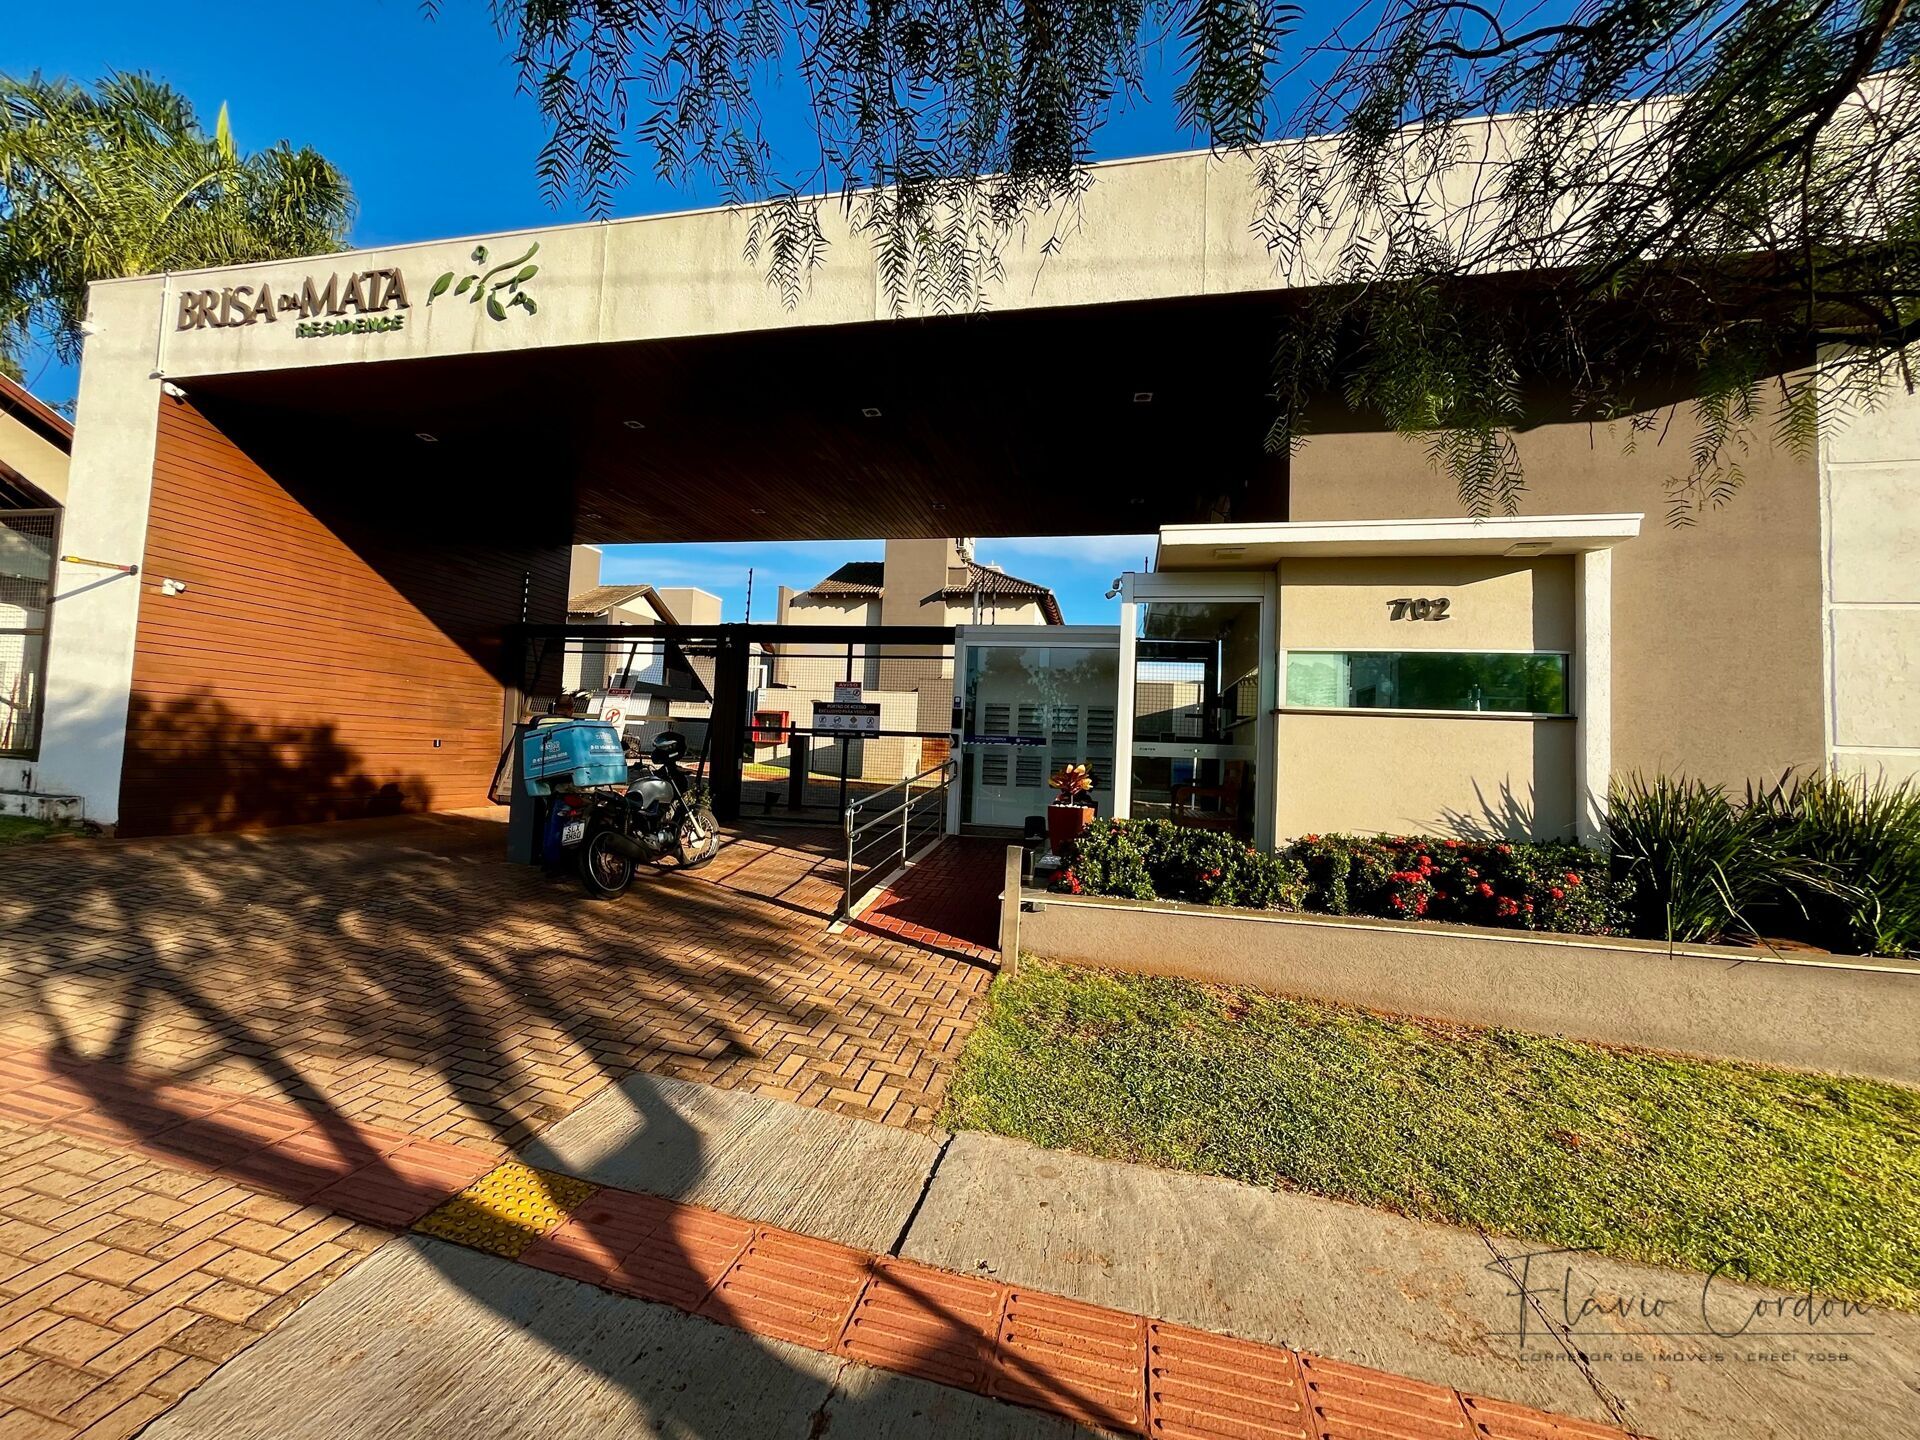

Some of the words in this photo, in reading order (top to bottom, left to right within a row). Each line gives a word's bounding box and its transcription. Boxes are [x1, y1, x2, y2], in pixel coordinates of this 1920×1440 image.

[176, 283, 278, 332] BRISA
[298, 268, 410, 320] MATA
[296, 316, 405, 339] RESIDENCE
[1386, 598, 1450, 621] 702
